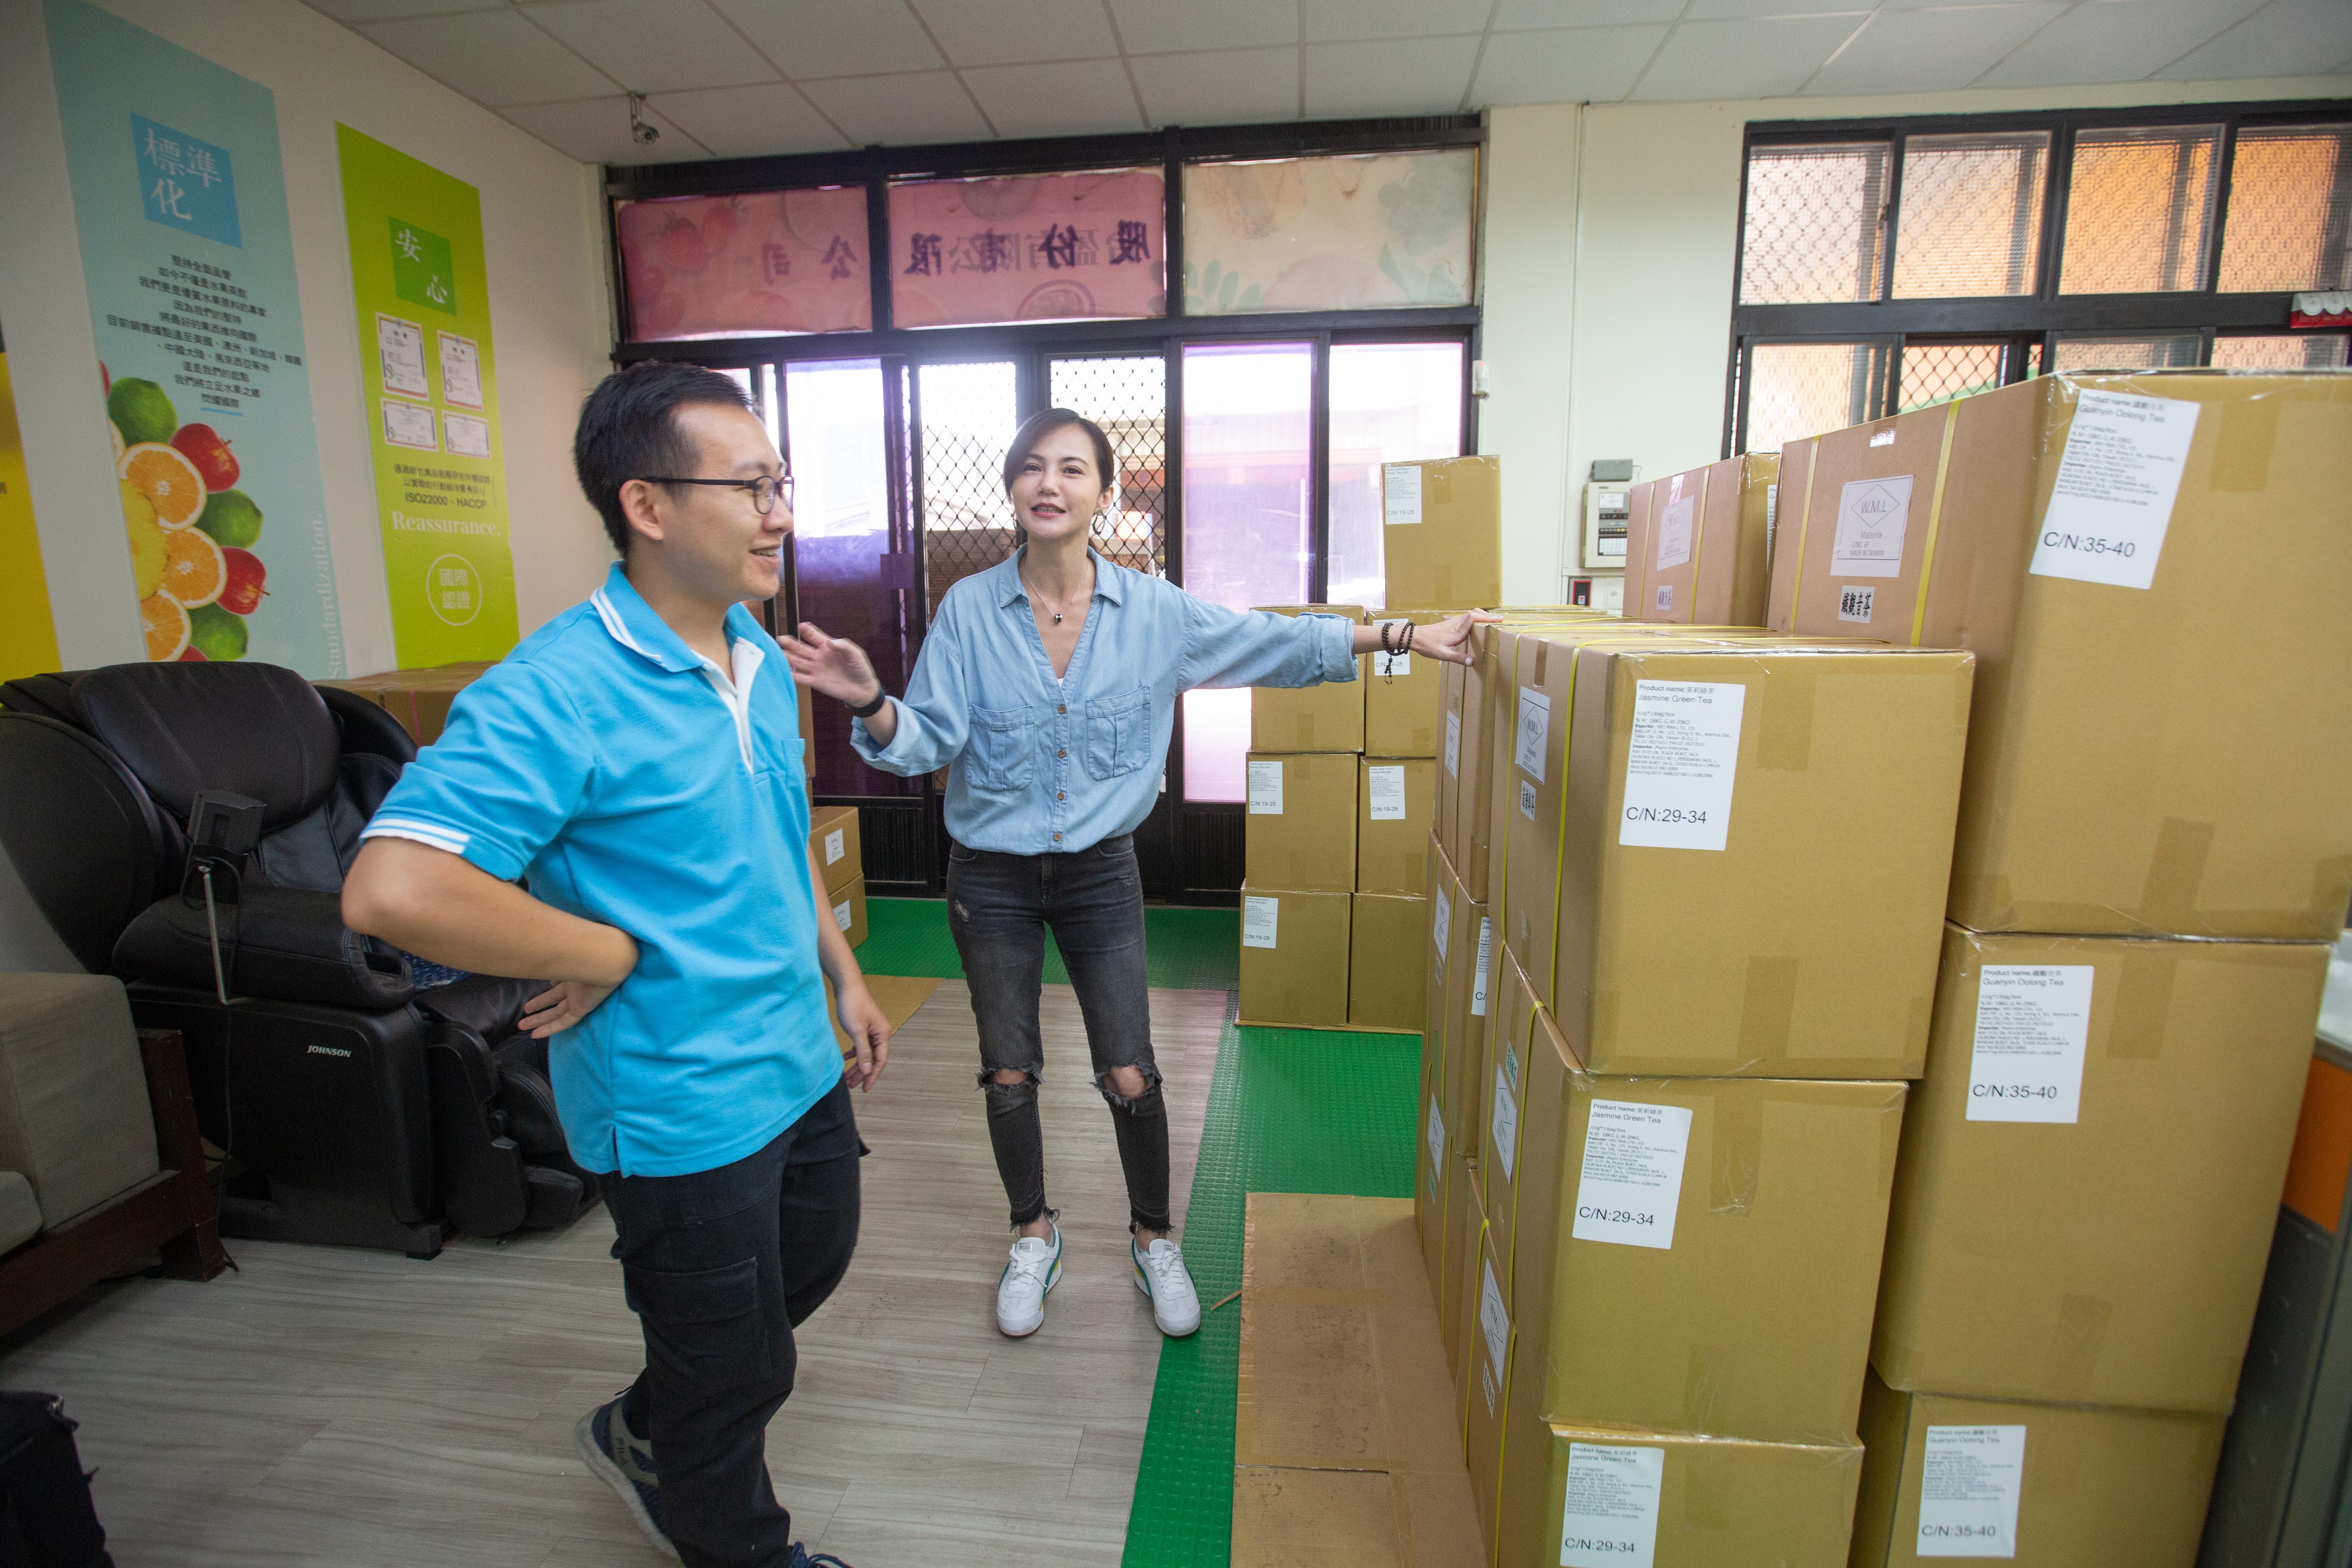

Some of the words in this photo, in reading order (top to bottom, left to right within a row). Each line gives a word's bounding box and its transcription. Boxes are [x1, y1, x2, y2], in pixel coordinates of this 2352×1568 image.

[144, 127, 221, 187] 標準
[150, 178, 192, 220] 化
[2115, 409, 2146, 422] Oolong
[2150, 414, 2165, 422] Tea
[1861, 499, 1886, 514] W.M.L
[392, 510, 501, 536] Reassurance.
[1860, 531, 1882, 540] Malaysia
[2044, 532, 2136, 557] C/N:35-40
[1627, 807, 1706, 823] C/N:29-34
[1983, 978, 2015, 987] Guanyin
[2018, 978, 2046, 987] Oolong
[307, 1045, 352, 1058] JOHNSON
[1973, 1084, 2057, 1099] C/N:35-40
[1592, 1111, 1621, 1120] Jasmine
[1580, 1207, 1654, 1225] C/N:29-34
[1922, 1525, 1996, 1537] C/N:35-40
[1565, 1538, 1634, 1552] C/N:29-34
